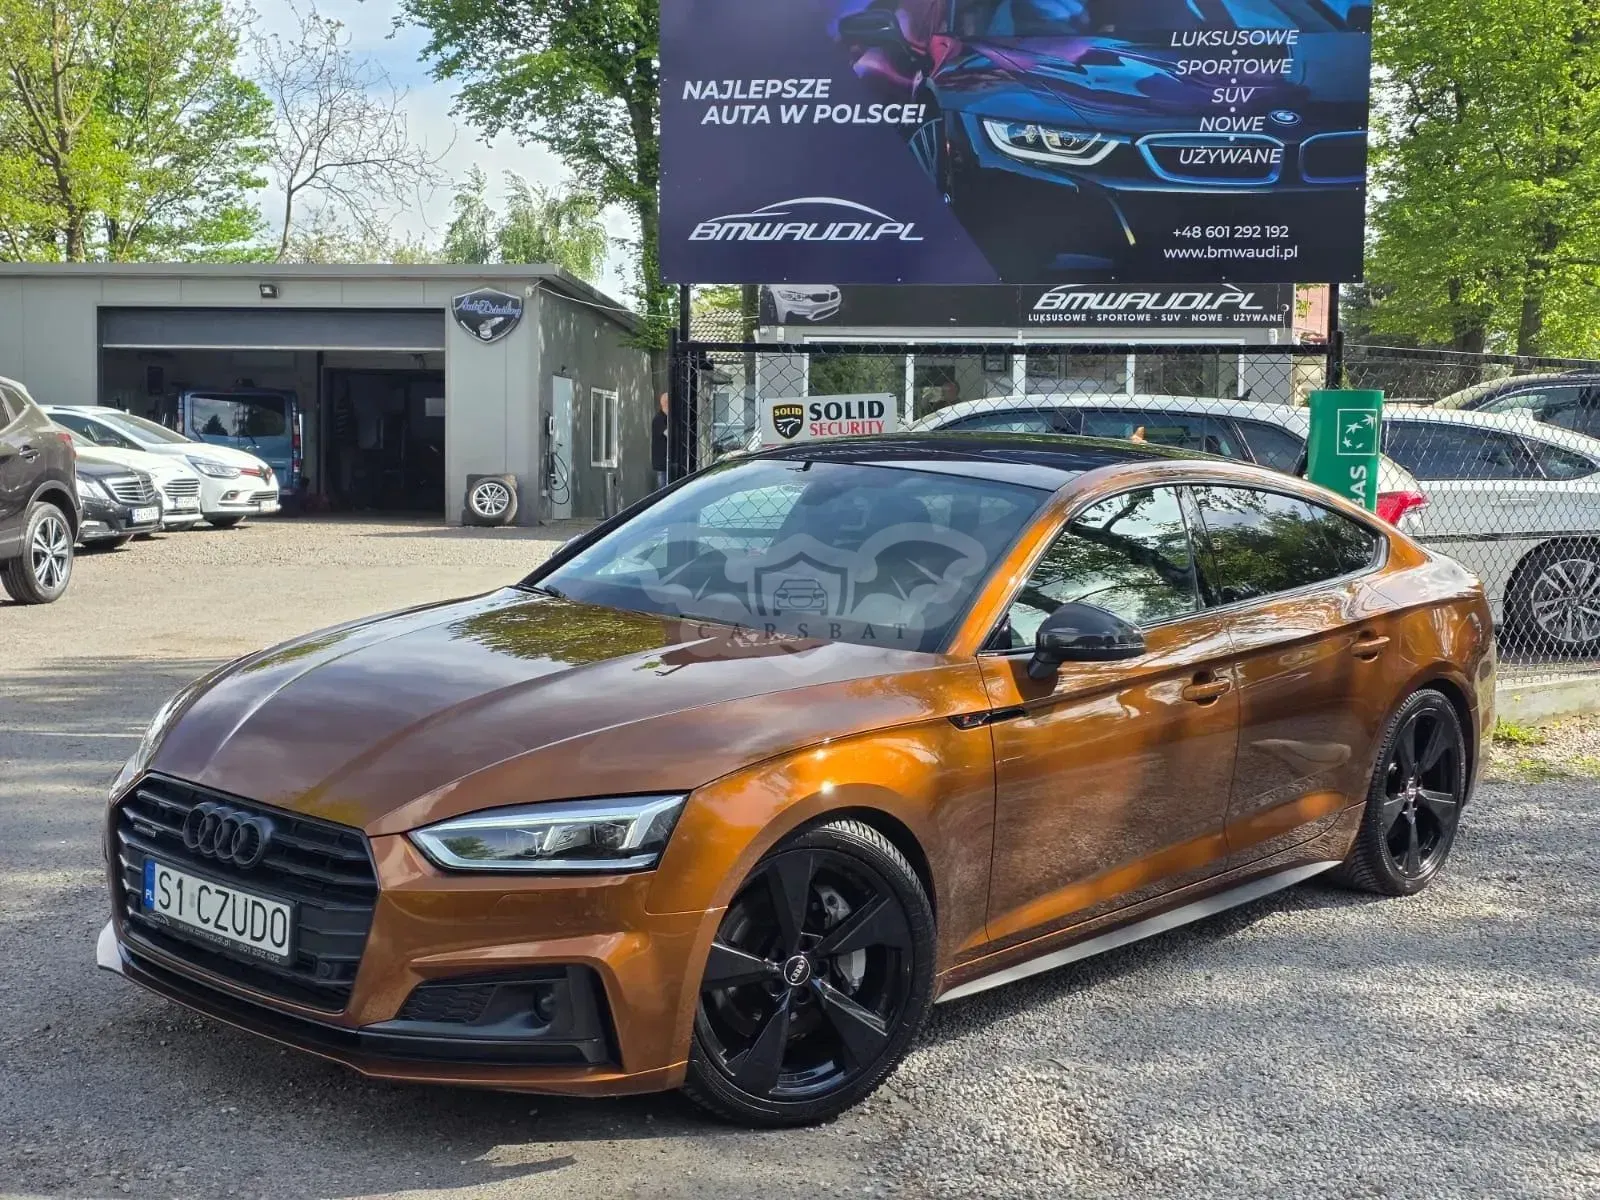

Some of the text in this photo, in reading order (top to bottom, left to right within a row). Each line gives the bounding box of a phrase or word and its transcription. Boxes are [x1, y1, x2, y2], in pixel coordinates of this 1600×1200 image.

[1170, 30, 1300, 47] LUKSUSOWE
[1175, 59, 1294, 75] SPORTOWE
[682, 78, 832, 100] NAJLEPSZE
[1212, 87, 1255, 103] SUV
[700, 103, 926, 125] AUTA W POLSCE!
[1199, 116, 1265, 132] NOWE
[1179, 146, 1283, 164] UŻYWANE
[688, 222, 924, 241] BMWAUDI.PL
[1172, 225, 1289, 239] +48 601 292 192
[1163, 245, 1298, 260] www.bmwaudi.pl
[1033, 292, 1264, 310] BMWAUDI.PL
[1028, 311, 1284, 323] LUKSUSOWE SPORTOWE SUV NOWE UŻYWANE
[774, 407, 802, 417] SOLID
[809, 400, 885, 422] SOLID
[809, 420, 885, 436] SECURITY
[145, 888, 154, 902] PL
[158, 871, 287, 948] S1 CZUDO
